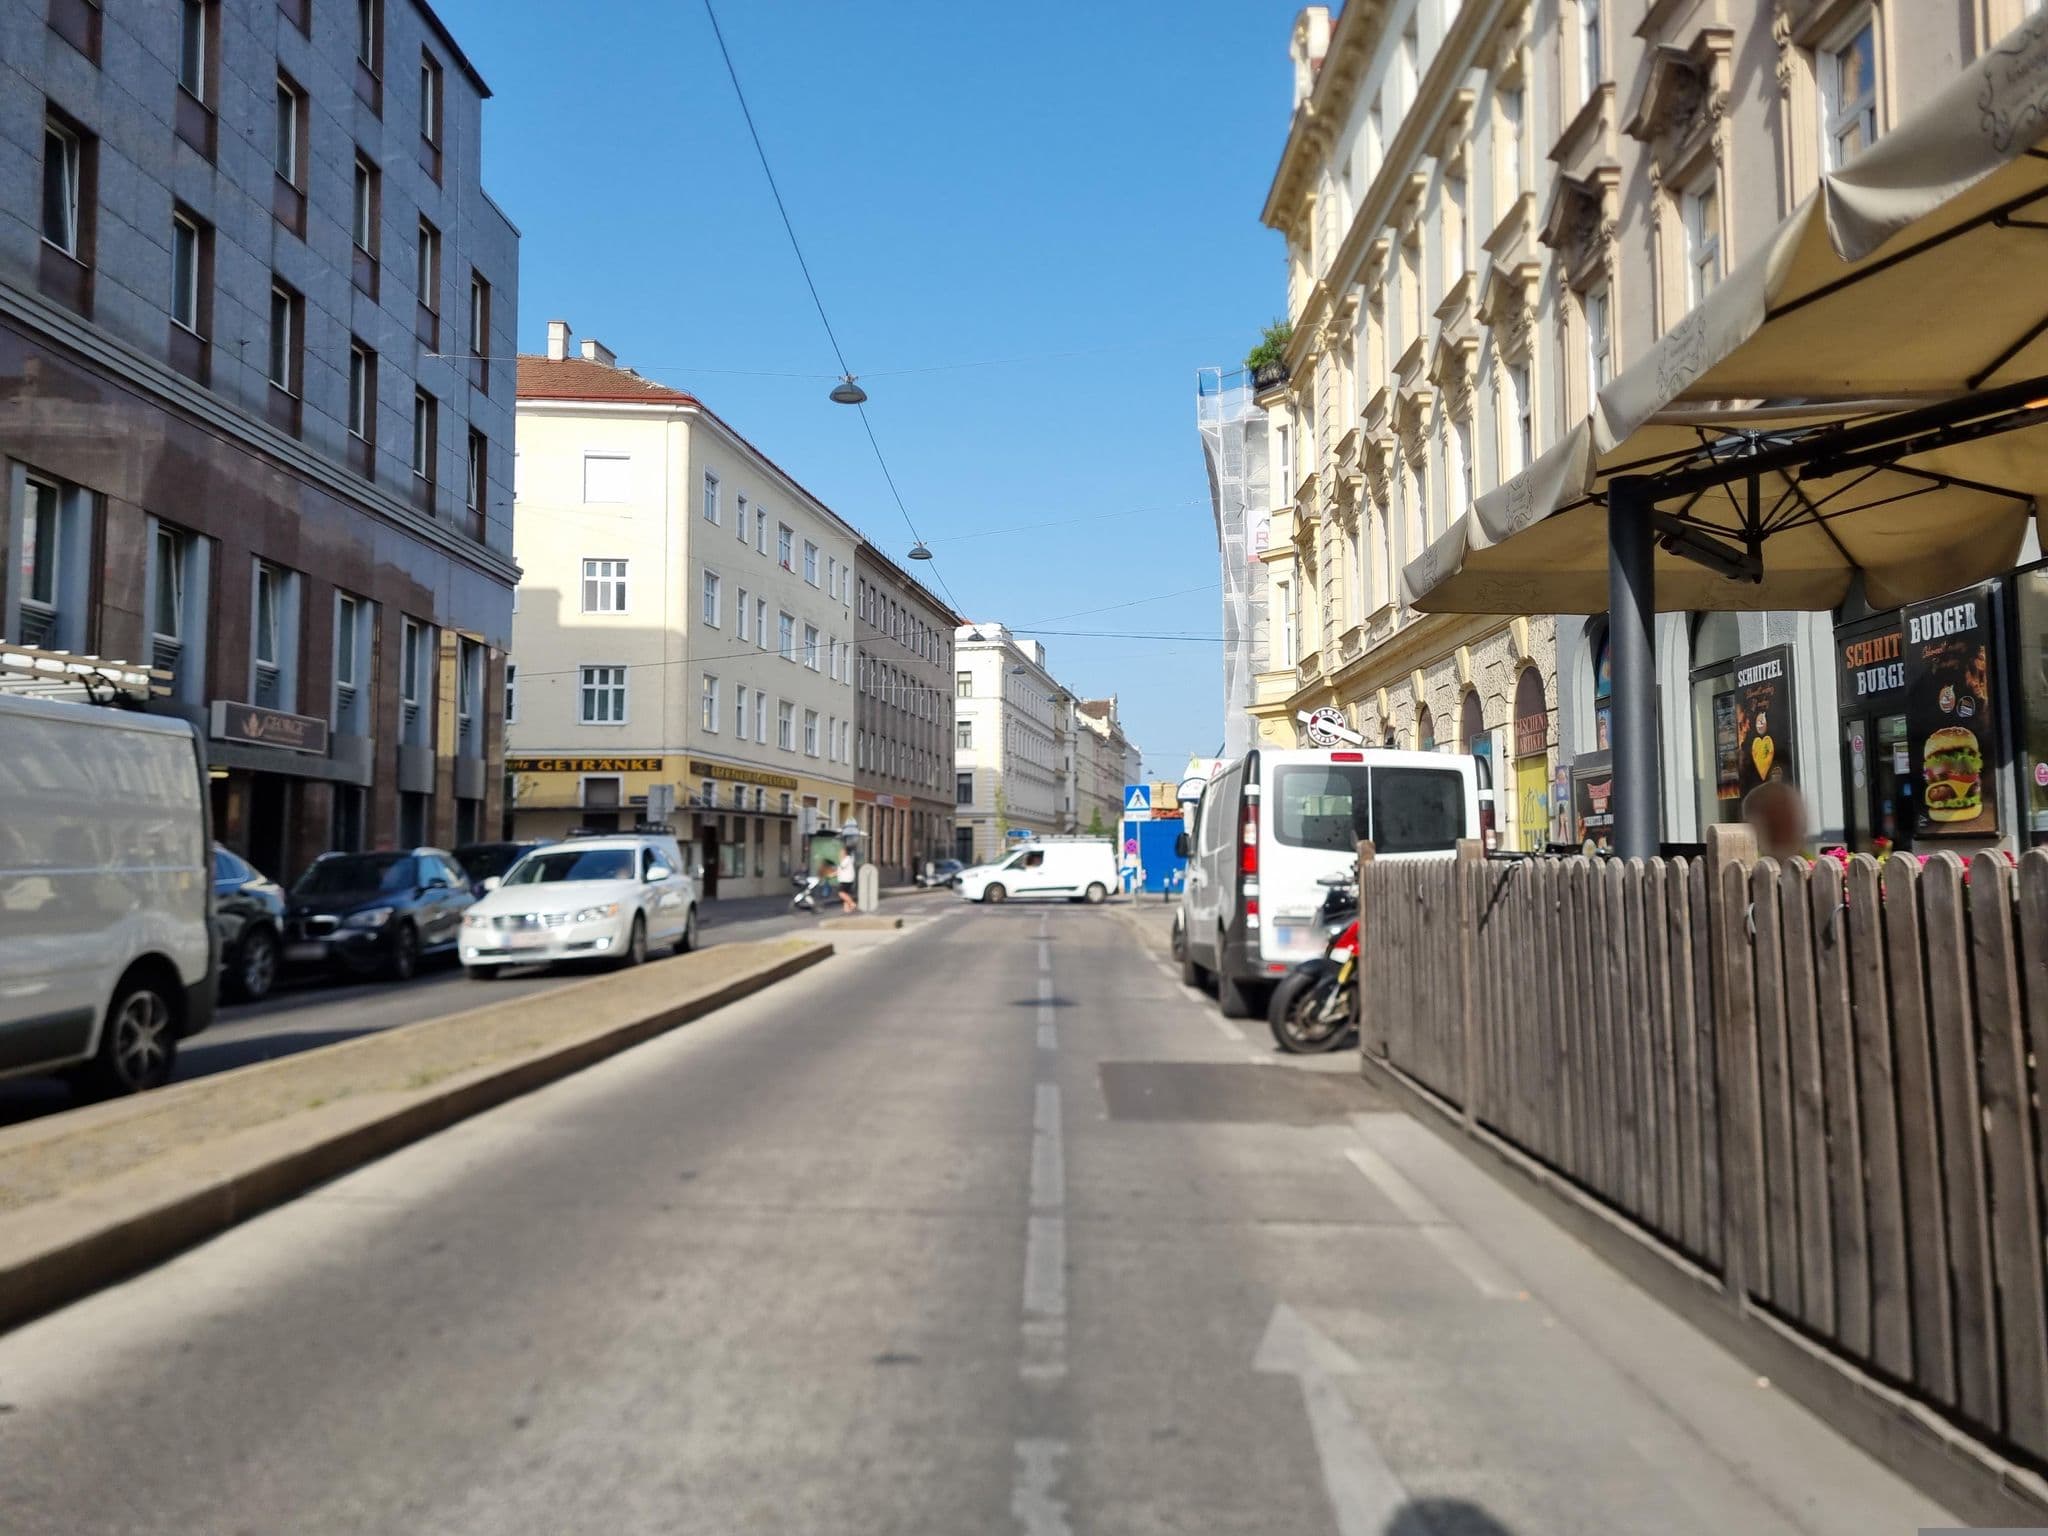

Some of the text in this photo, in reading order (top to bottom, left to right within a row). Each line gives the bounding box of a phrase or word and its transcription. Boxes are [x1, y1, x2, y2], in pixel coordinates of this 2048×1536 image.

[1909, 602, 1978, 645] BURGER
[1737, 659, 1783, 688] SCHNITZEL
[537, 758, 657, 771] GETRÄNKE
